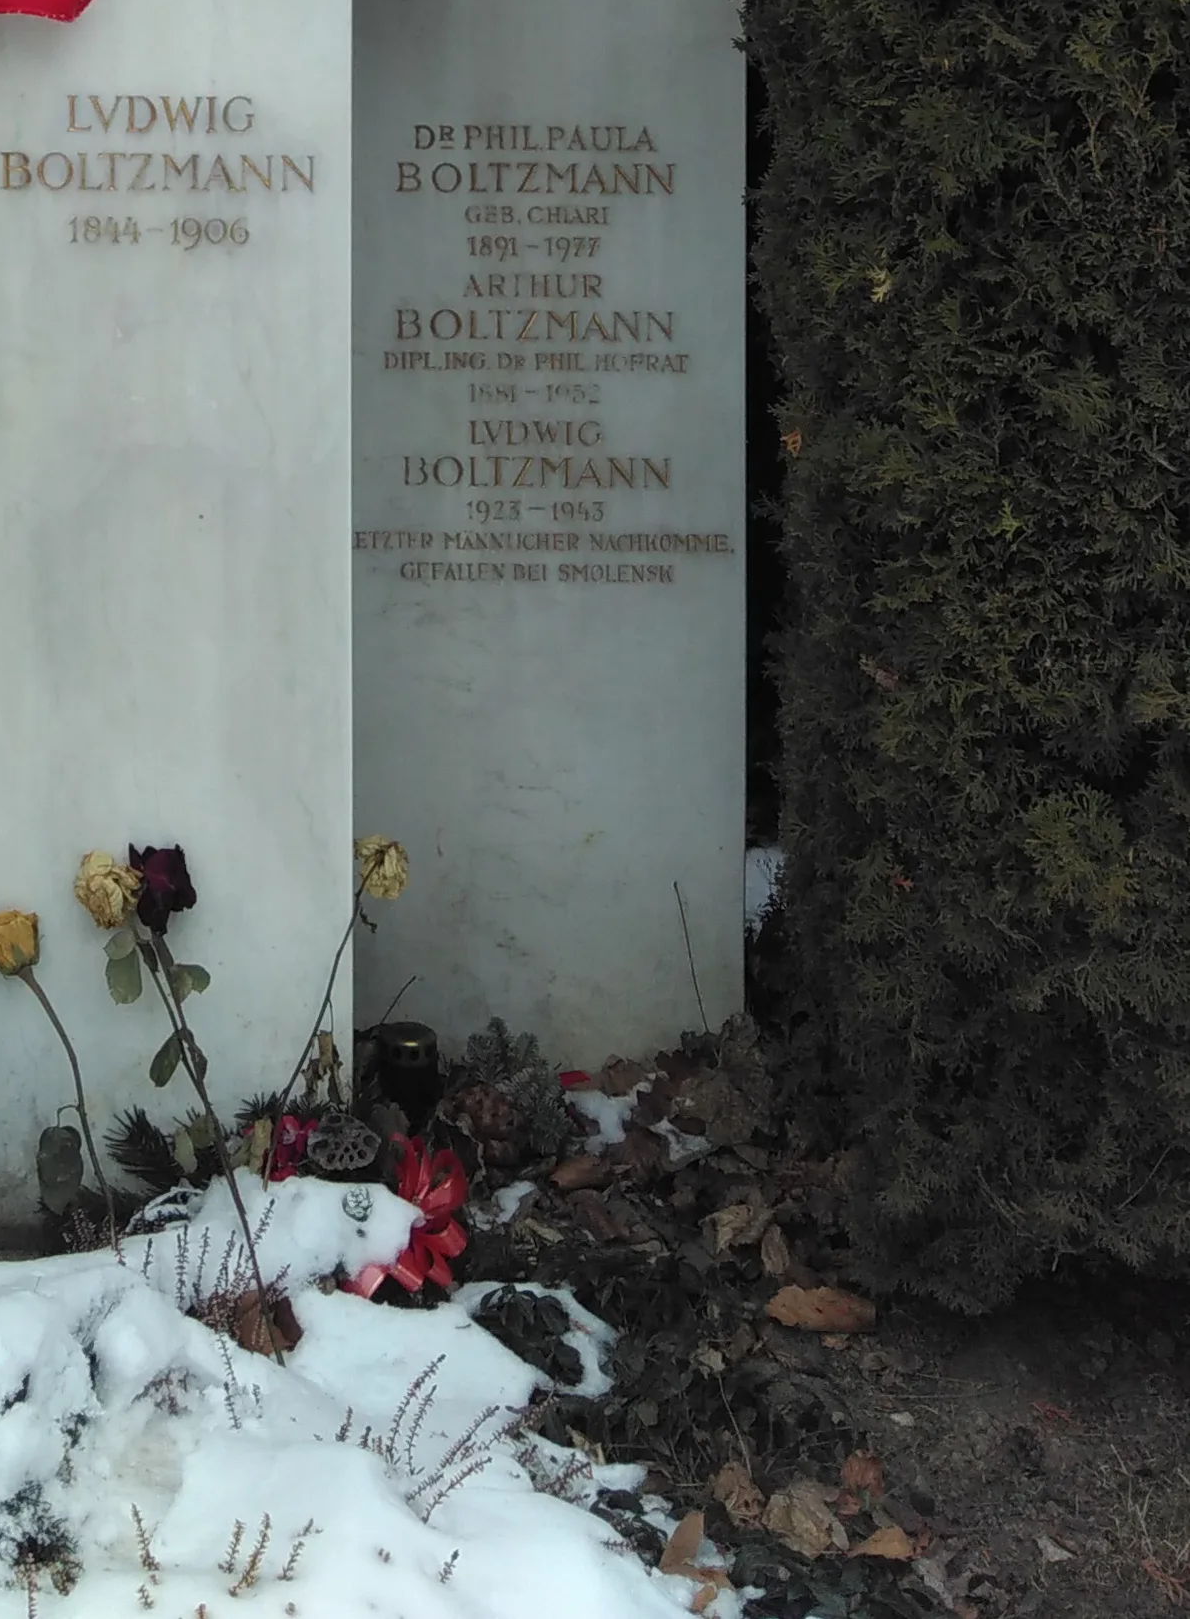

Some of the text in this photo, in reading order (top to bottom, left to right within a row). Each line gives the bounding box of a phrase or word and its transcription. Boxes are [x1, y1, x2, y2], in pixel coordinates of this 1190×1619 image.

[66, 94, 254, 133] LVDWIG
[0, 151, 316, 193] BOLTZMANN
[395, 161, 677, 195] BOLTZMANN
[527, 205, 611, 226] CHIARI
[463, 273, 604, 299] ARTHUR
[395, 308, 675, 343] BOLTZMANN
[468, 419, 603, 446] LVDWIG
[403, 455, 672, 489] BOLTZMANN
[512, 561, 549, 583] BEI
[557, 562, 676, 584] SMOLENSK
